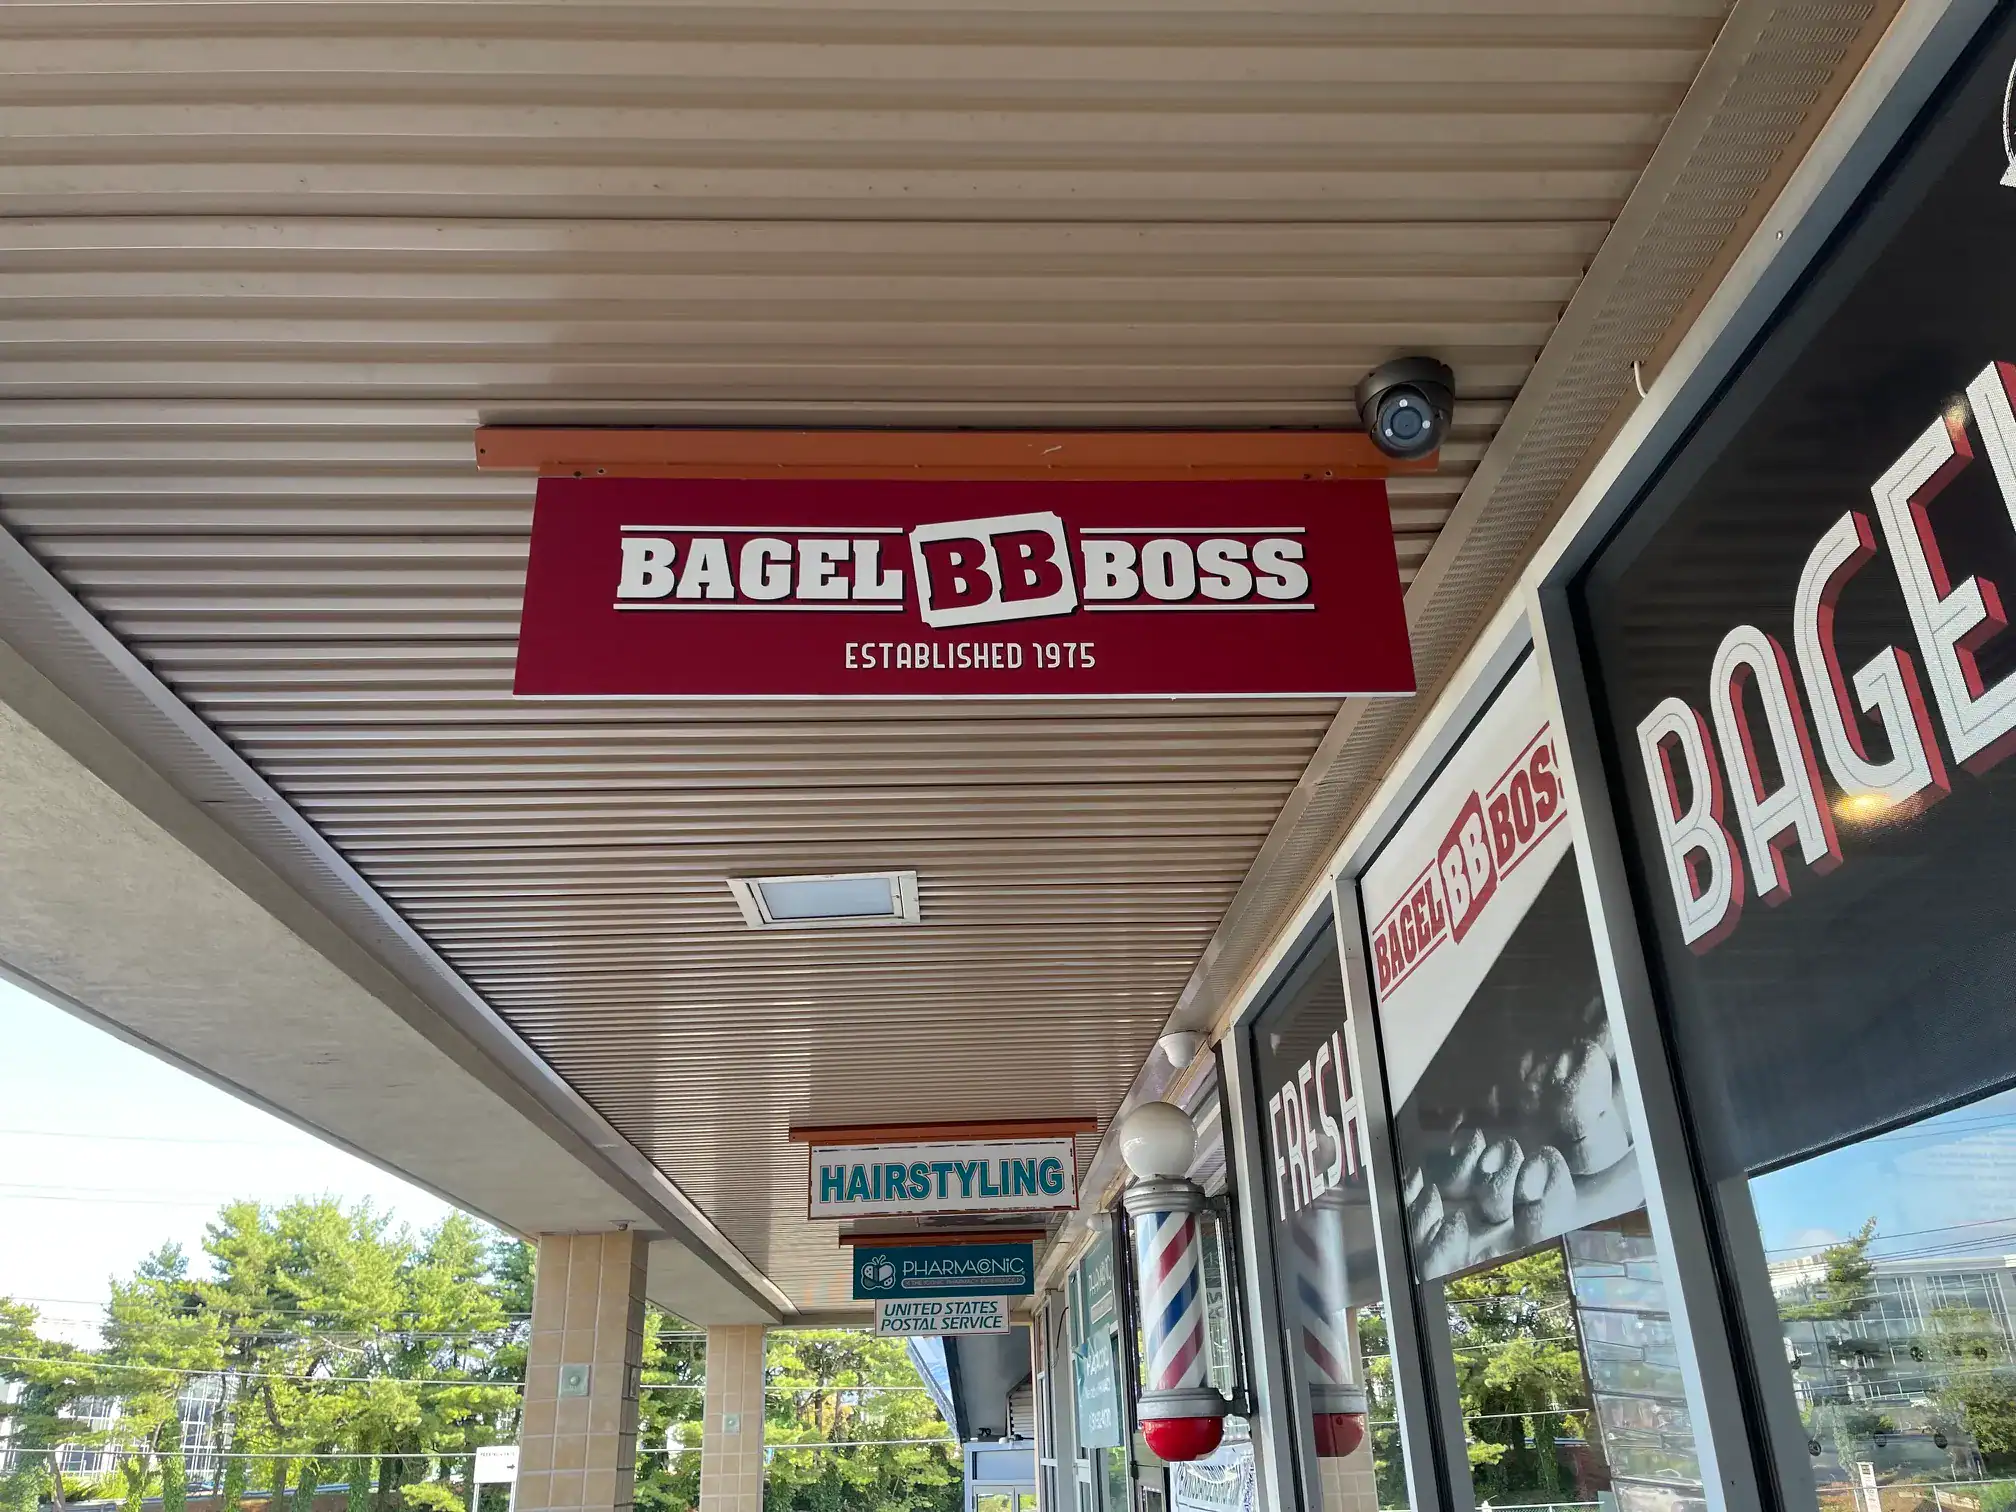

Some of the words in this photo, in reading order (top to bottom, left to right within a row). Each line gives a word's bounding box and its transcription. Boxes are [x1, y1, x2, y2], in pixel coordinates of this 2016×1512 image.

[617, 537, 904, 601] BAGEL
[922, 527, 1068, 612] BB
[1081, 537, 1311, 602] BOSS
[845, 641, 1023, 671] ESTABLISHED
[1034, 642, 1096, 670] 1975
[1373, 875, 1447, 994] BAGEL
[1442, 811, 1493, 921] BB
[1487, 736, 1565, 864] BOS
[1269, 1020, 1366, 1222] FRESH
[819, 1157, 1066, 1204] HAIRSTYLING
[880, 1317, 938, 1332] POSTAL
[940, 1315, 1003, 1330] SERVICE
[884, 1302, 943, 1317] UNITED
[944, 1300, 999, 1316] STATES
